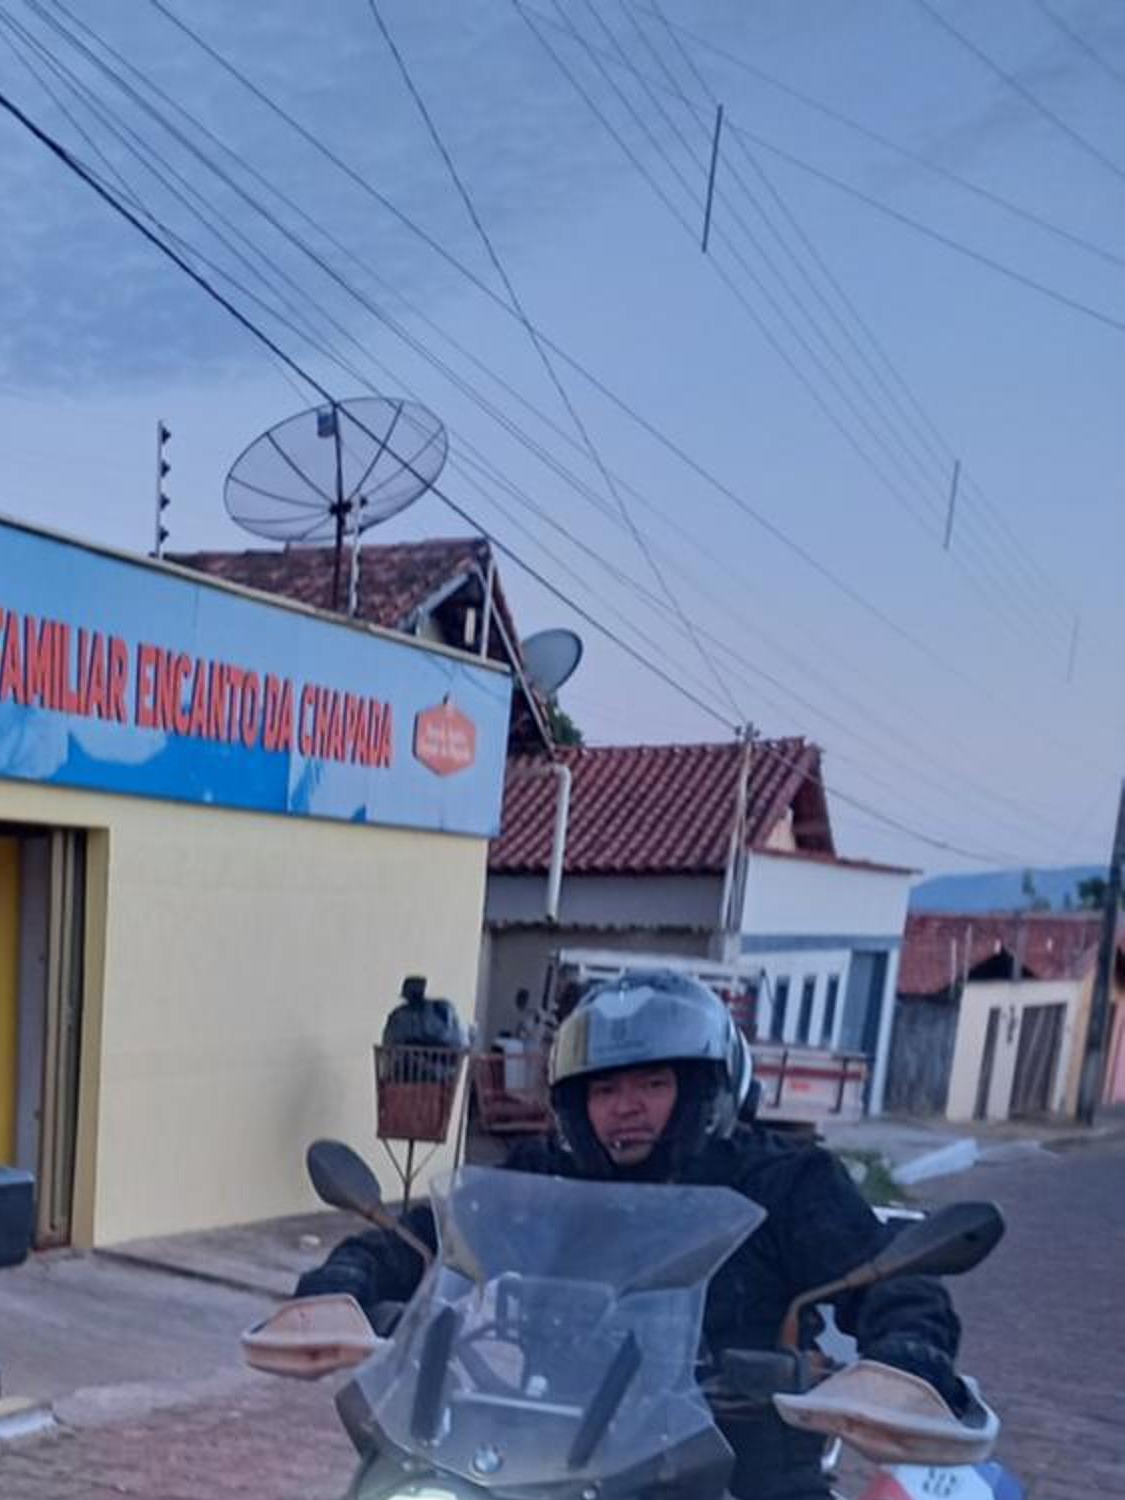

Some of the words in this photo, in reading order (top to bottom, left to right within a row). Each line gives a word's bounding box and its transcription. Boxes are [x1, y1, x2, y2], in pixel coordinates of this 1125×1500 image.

[135, 642, 262, 749] ENCANTO
[261, 673, 294, 752] DA
[297, 683, 391, 768] CHAPADA
